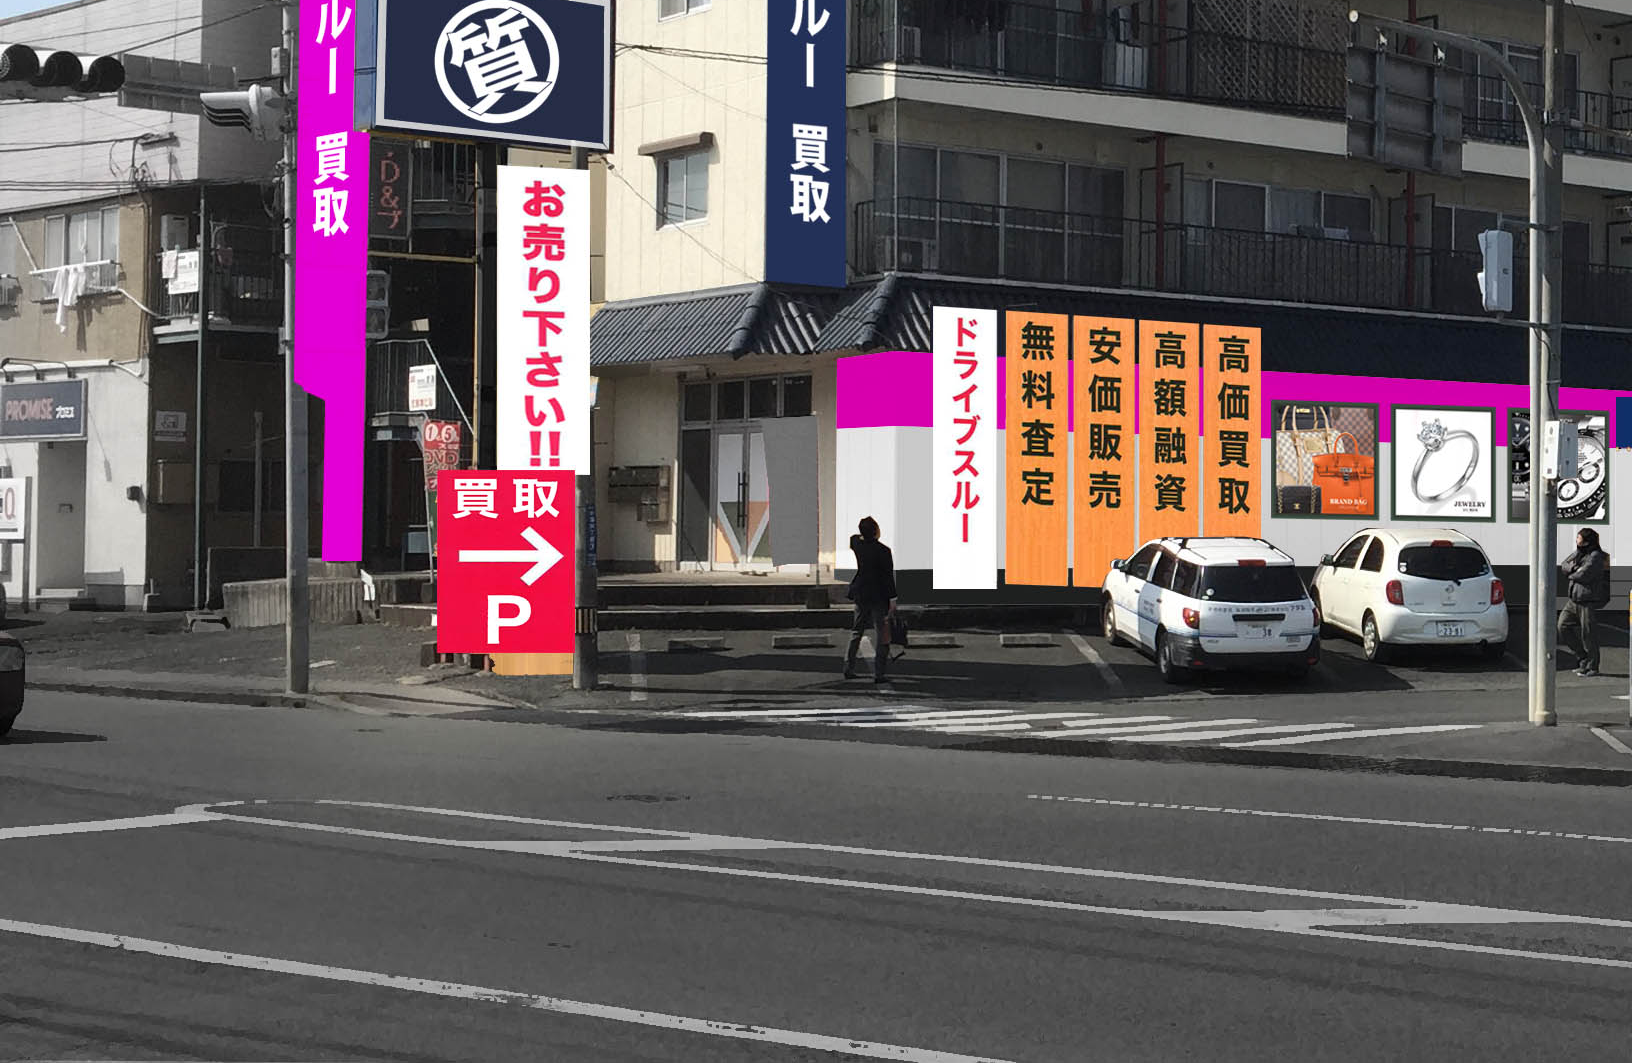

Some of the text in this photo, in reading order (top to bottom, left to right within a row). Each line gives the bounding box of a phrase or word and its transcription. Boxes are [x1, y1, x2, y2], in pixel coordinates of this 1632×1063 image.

[446, 5, 553, 116] 質
[312, 131, 350, 237] 買取
[789, 123, 831, 224] 買取
[522, 180, 566, 468] お売り下さい!!
[6, 398, 53, 421] PROMISE
[951, 317, 981, 543] ドライブスルー
[1021, 321, 1056, 507] 無料査定
[1088, 326, 1123, 509] 安価販売
[1153, 330, 1187, 513] 高額融資
[1217, 335, 1251, 515] 高価買取
[452, 478, 560, 519] 買取
[1454, 500, 1486, 508] JEWELRY
[487, 594, 532, 645] P
